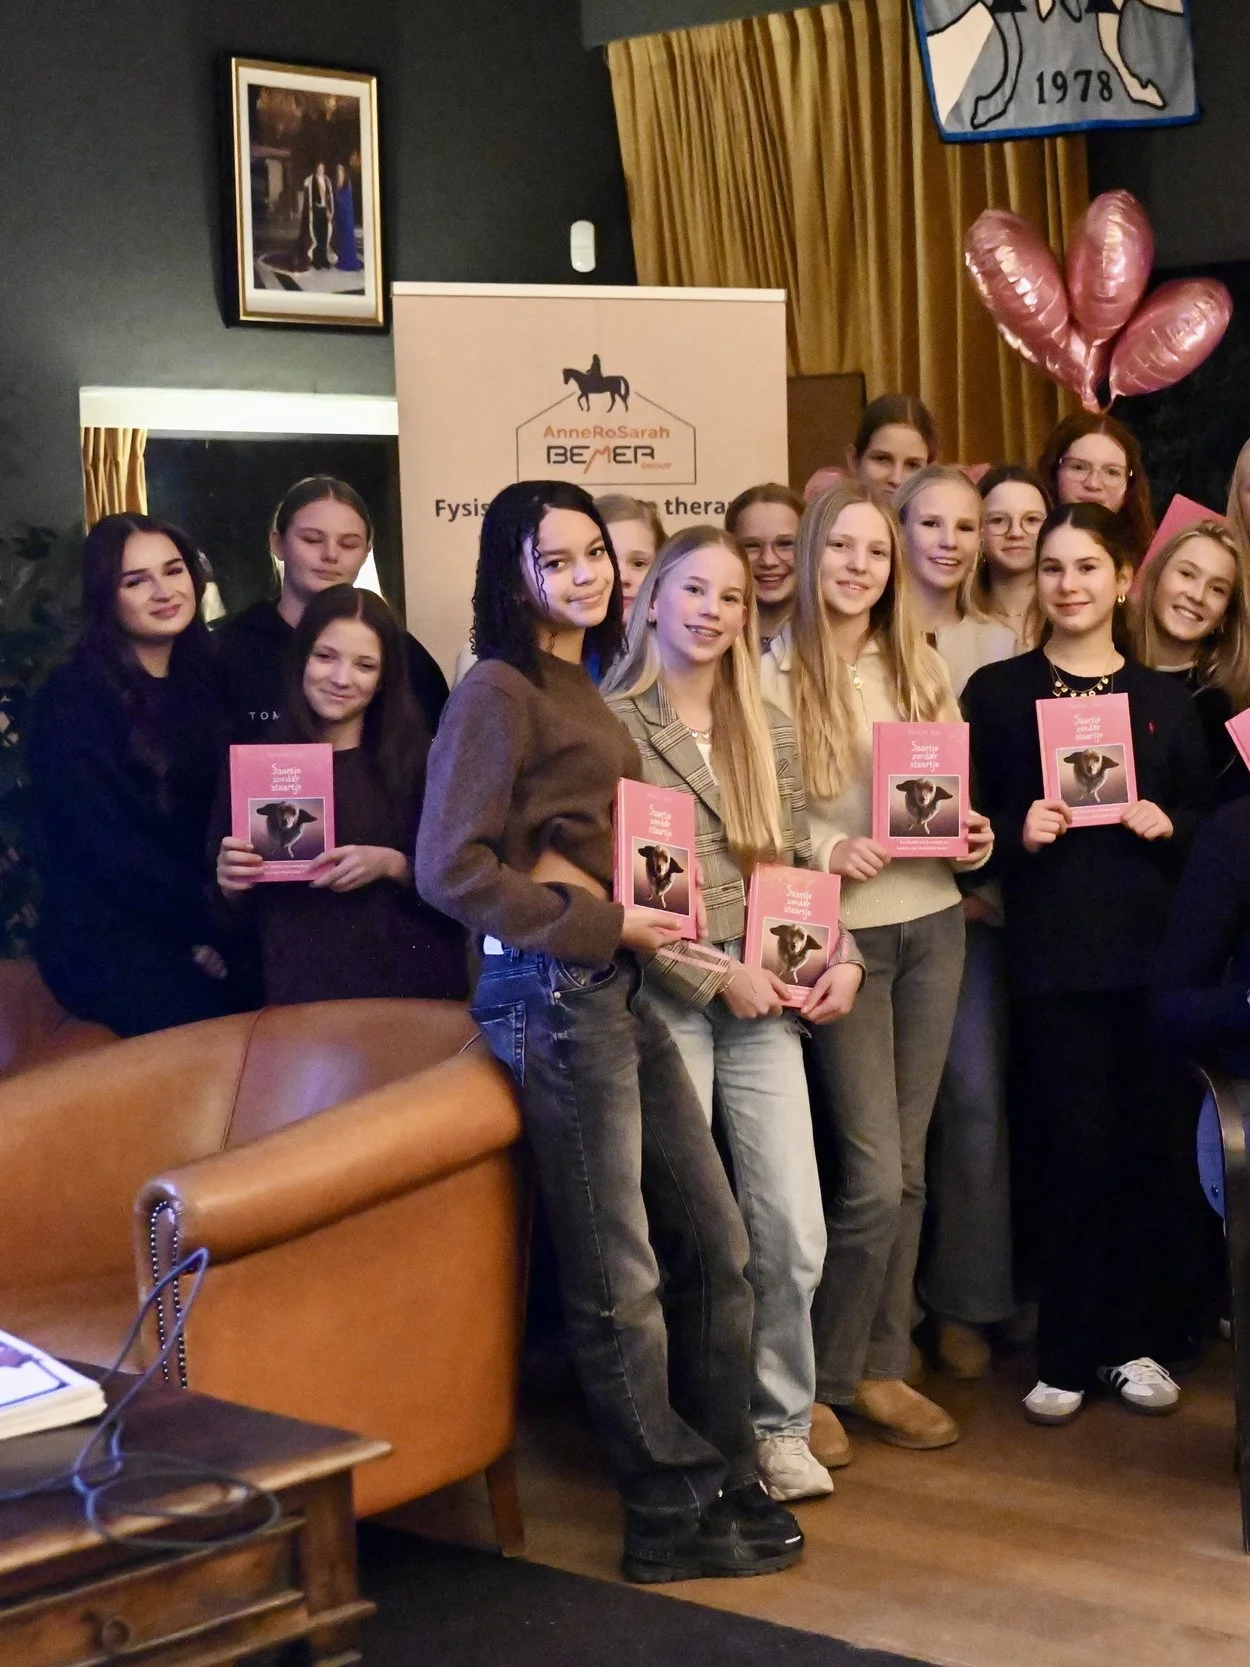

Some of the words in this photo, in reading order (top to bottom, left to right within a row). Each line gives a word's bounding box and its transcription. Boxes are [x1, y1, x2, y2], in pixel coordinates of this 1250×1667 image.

[1036, 69, 1113, 104] 1978
[543, 425, 670, 440] AnneRoSarah
[546, 445, 655, 475] BEMER
[434, 499, 491, 522] Fysis
[664, 497, 731, 515] thera
